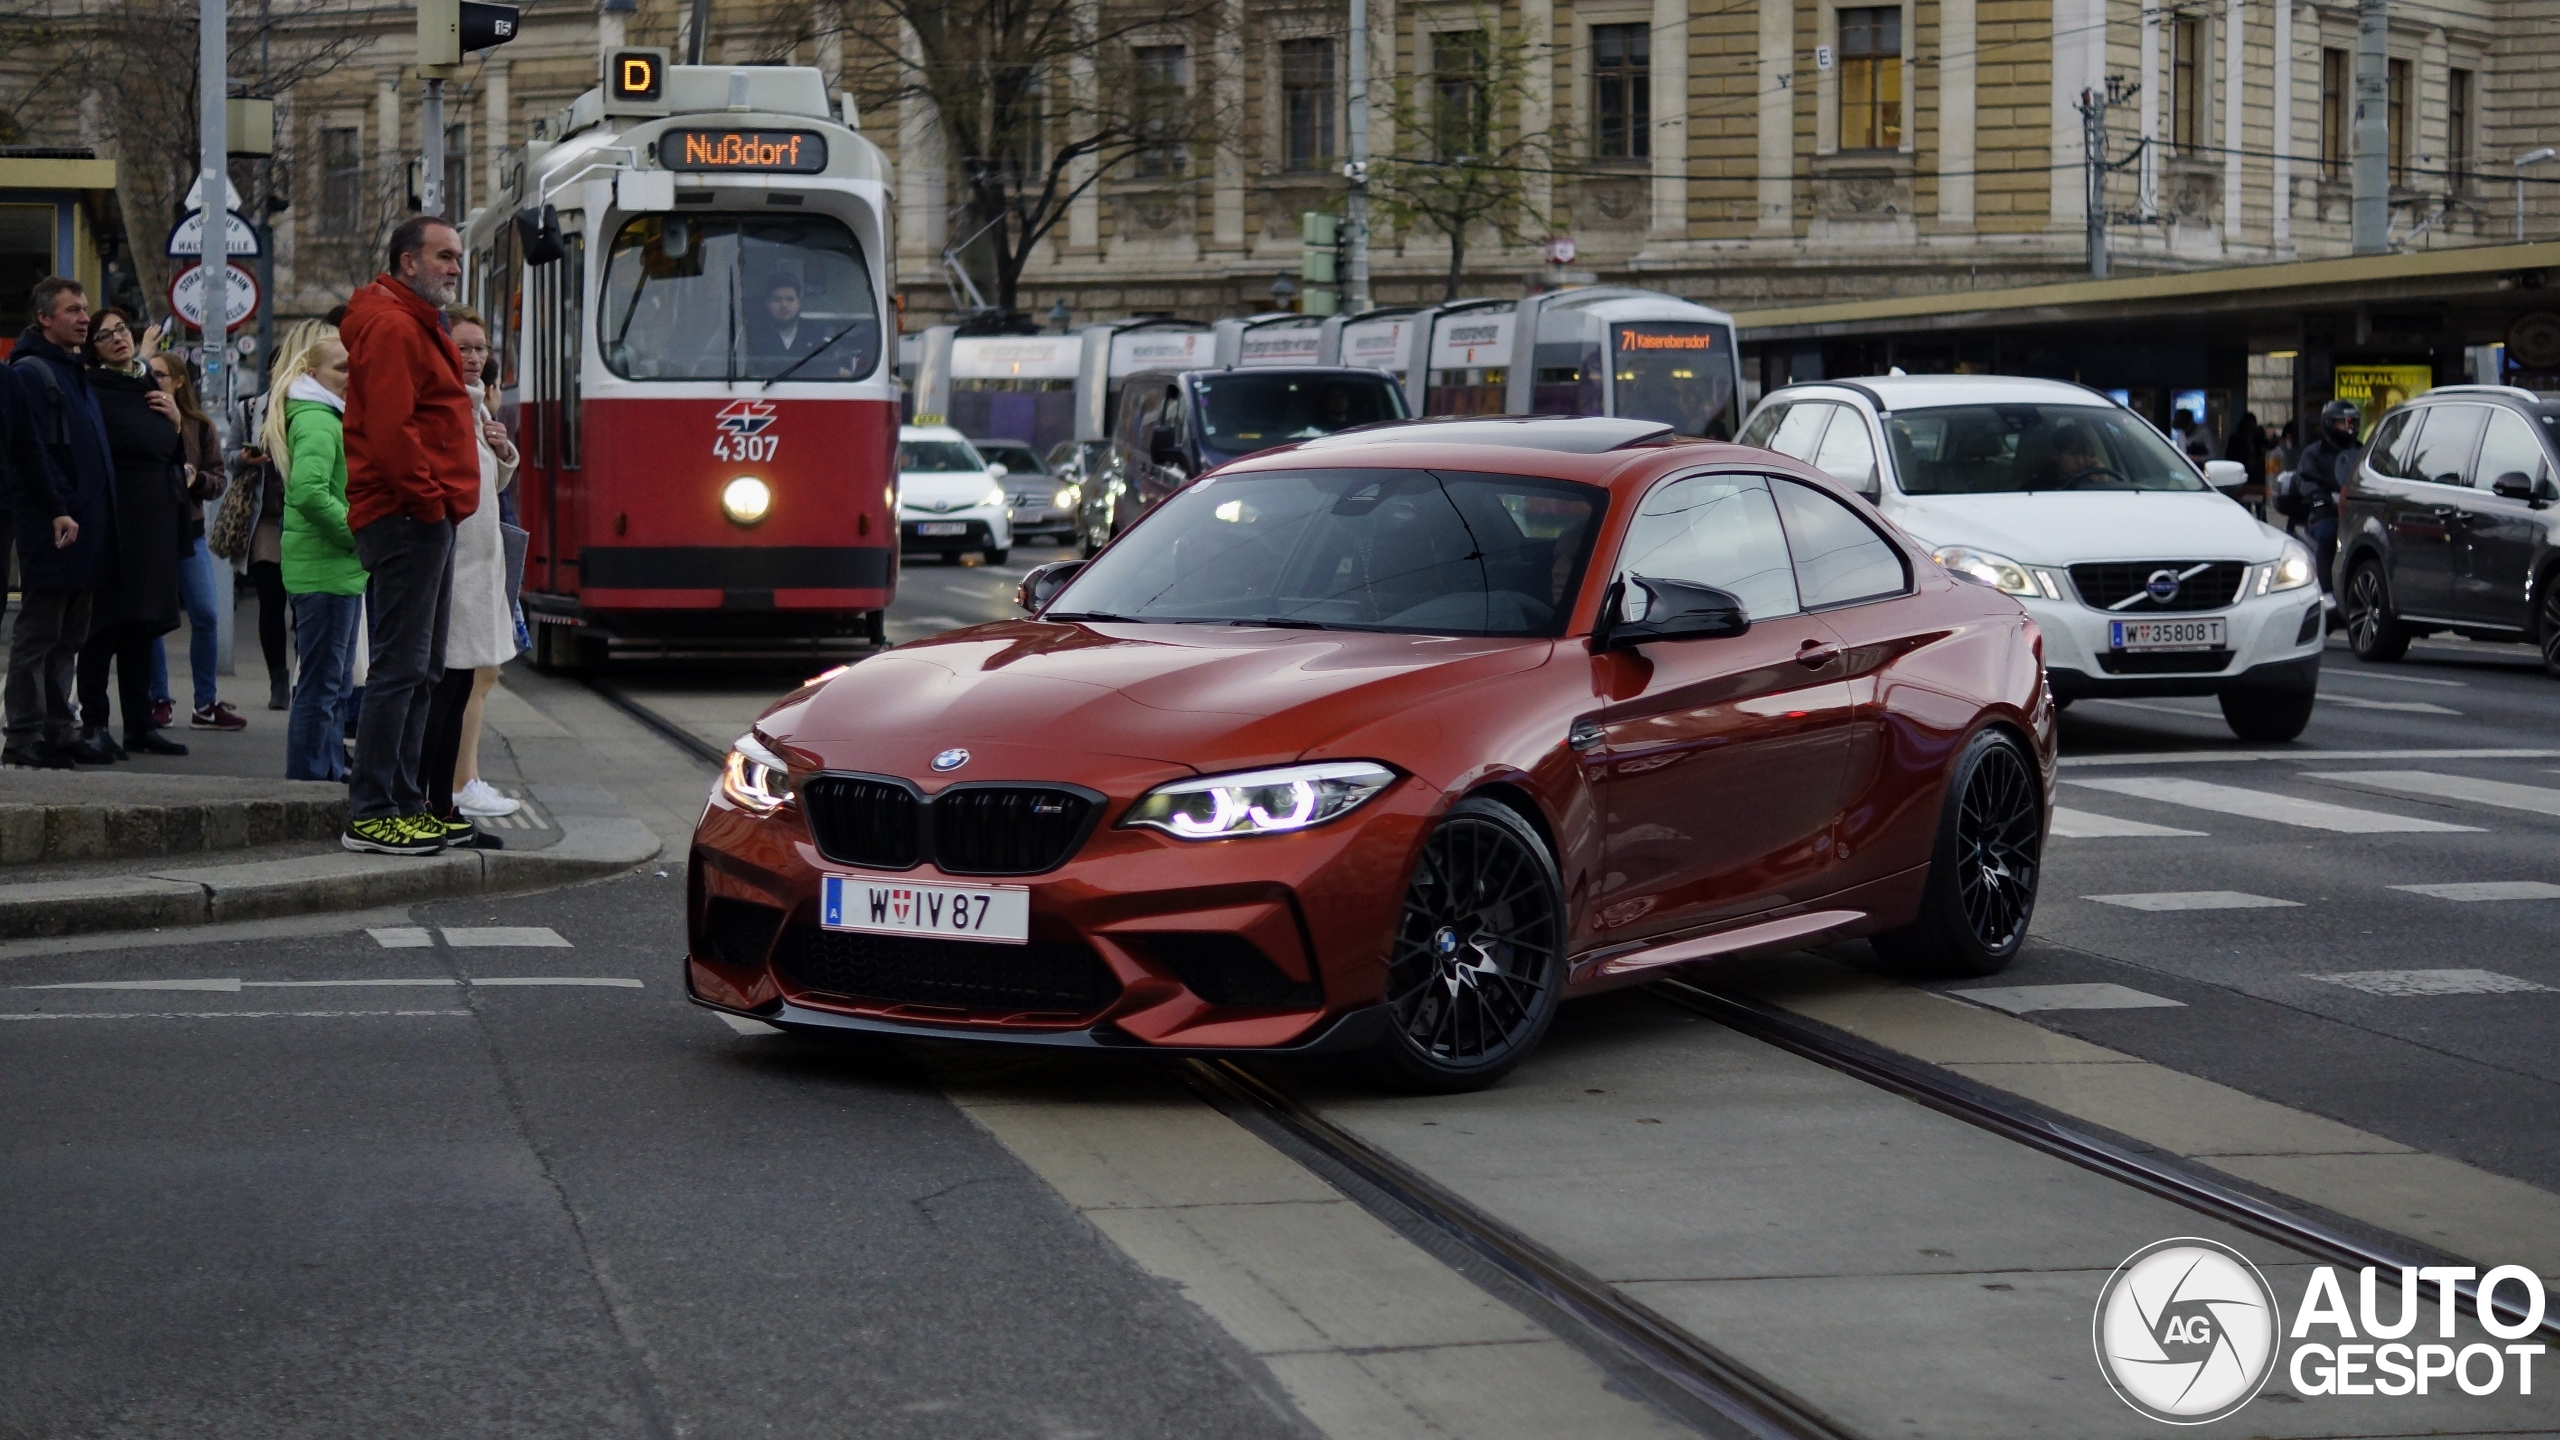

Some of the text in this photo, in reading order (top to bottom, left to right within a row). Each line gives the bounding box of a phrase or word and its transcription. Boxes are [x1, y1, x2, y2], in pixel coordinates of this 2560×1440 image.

[497, 22, 510, 35] 15
[1819, 49, 1829, 65] E
[624, 60, 651, 91] D
[686, 133, 802, 165] Nußdorf
[1622, 331, 1710, 351] 71 Kaiserebersdorf
[2341, 373, 2396, 385] VIELFALT
[2340, 386, 2372, 398] BILLA
[713, 435, 779, 462] 4307
[2125, 623, 2219, 643] W 35808 T
[869, 887, 889, 924] W
[953, 893, 990, 930] 87
